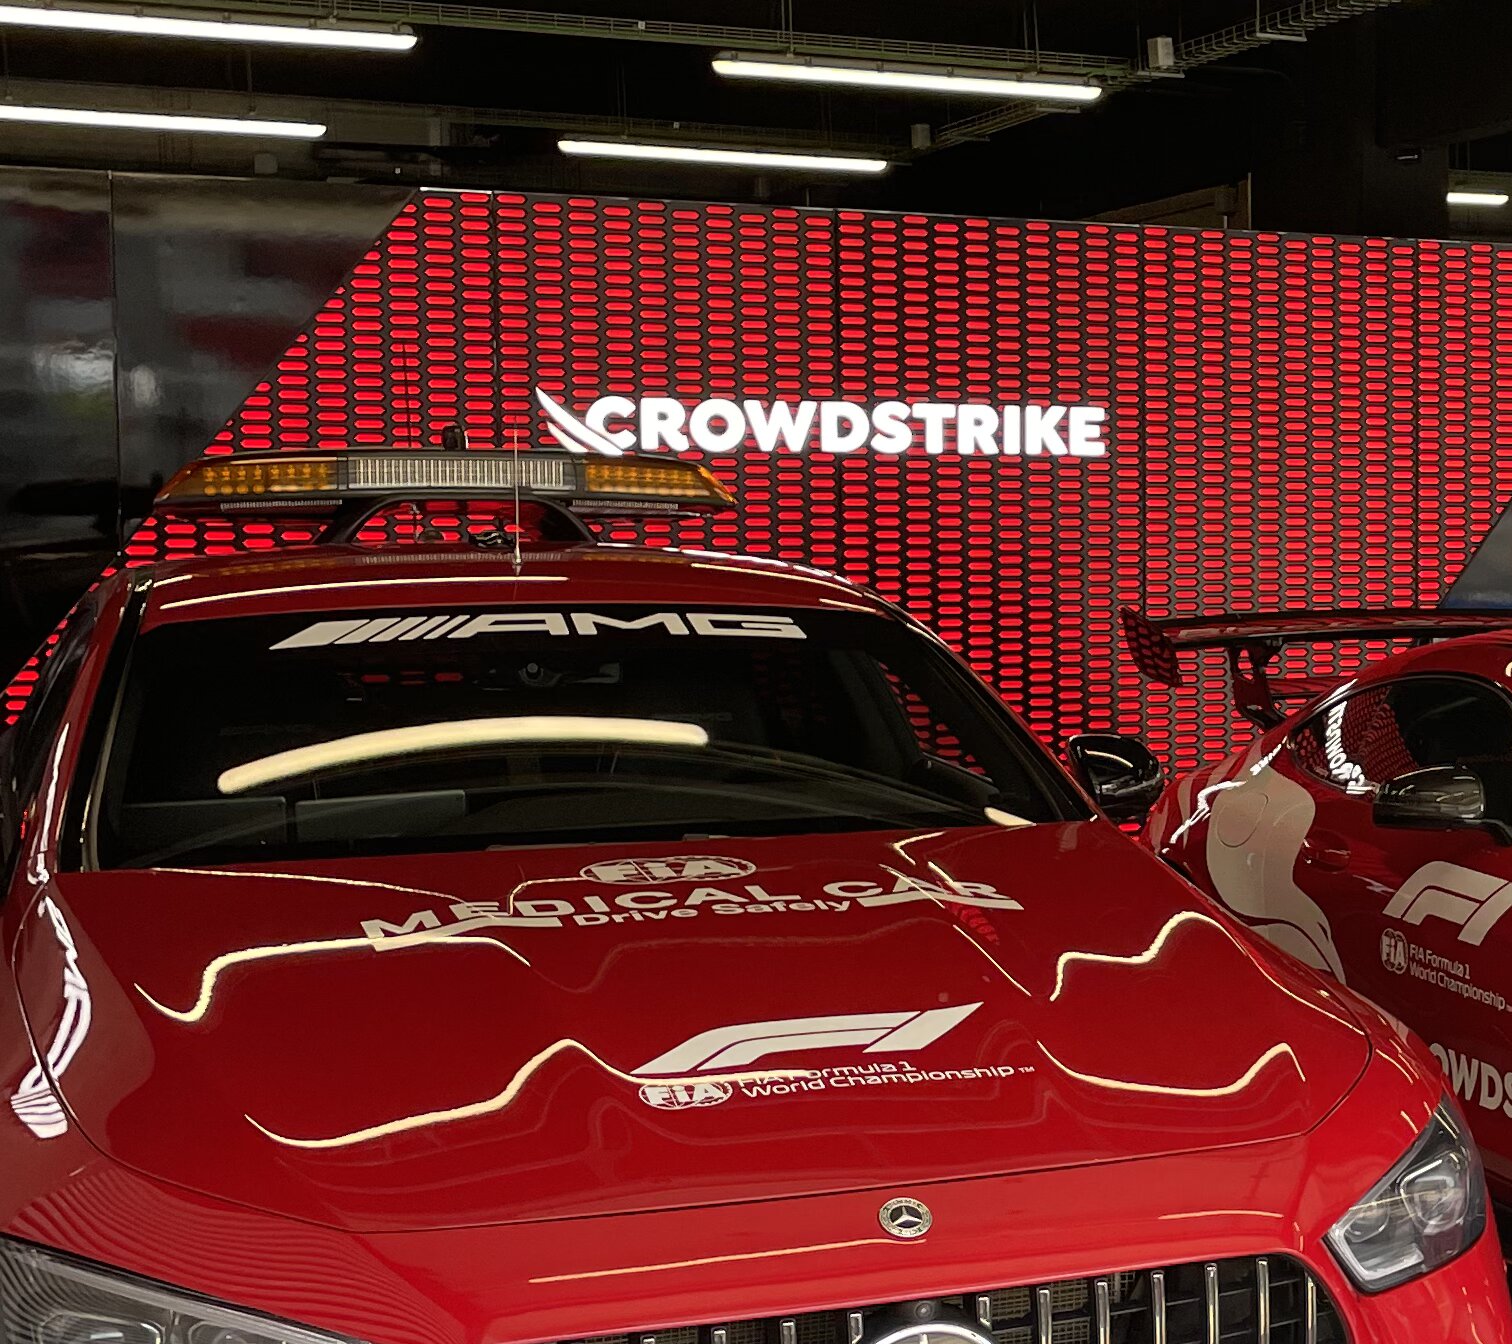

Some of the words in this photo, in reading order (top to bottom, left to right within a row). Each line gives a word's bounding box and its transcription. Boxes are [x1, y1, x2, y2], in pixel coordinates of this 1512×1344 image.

[584, 395, 1107, 457] CROWDSTRIKE
[447, 612, 807, 639] AMG
[360, 885, 802, 939] MEDICAL
[823, 877, 1012, 900] CAR
[571, 907, 699, 927] Drive
[711, 899, 851, 915] Safely
[1425, 950, 1465, 979] Formula
[1409, 960, 1437, 985] World
[1437, 971, 1506, 1012] Championship
[898, 1060, 917, 1072] 1
[741, 1078, 826, 1098] World
[830, 1066, 1015, 1088] Championship
